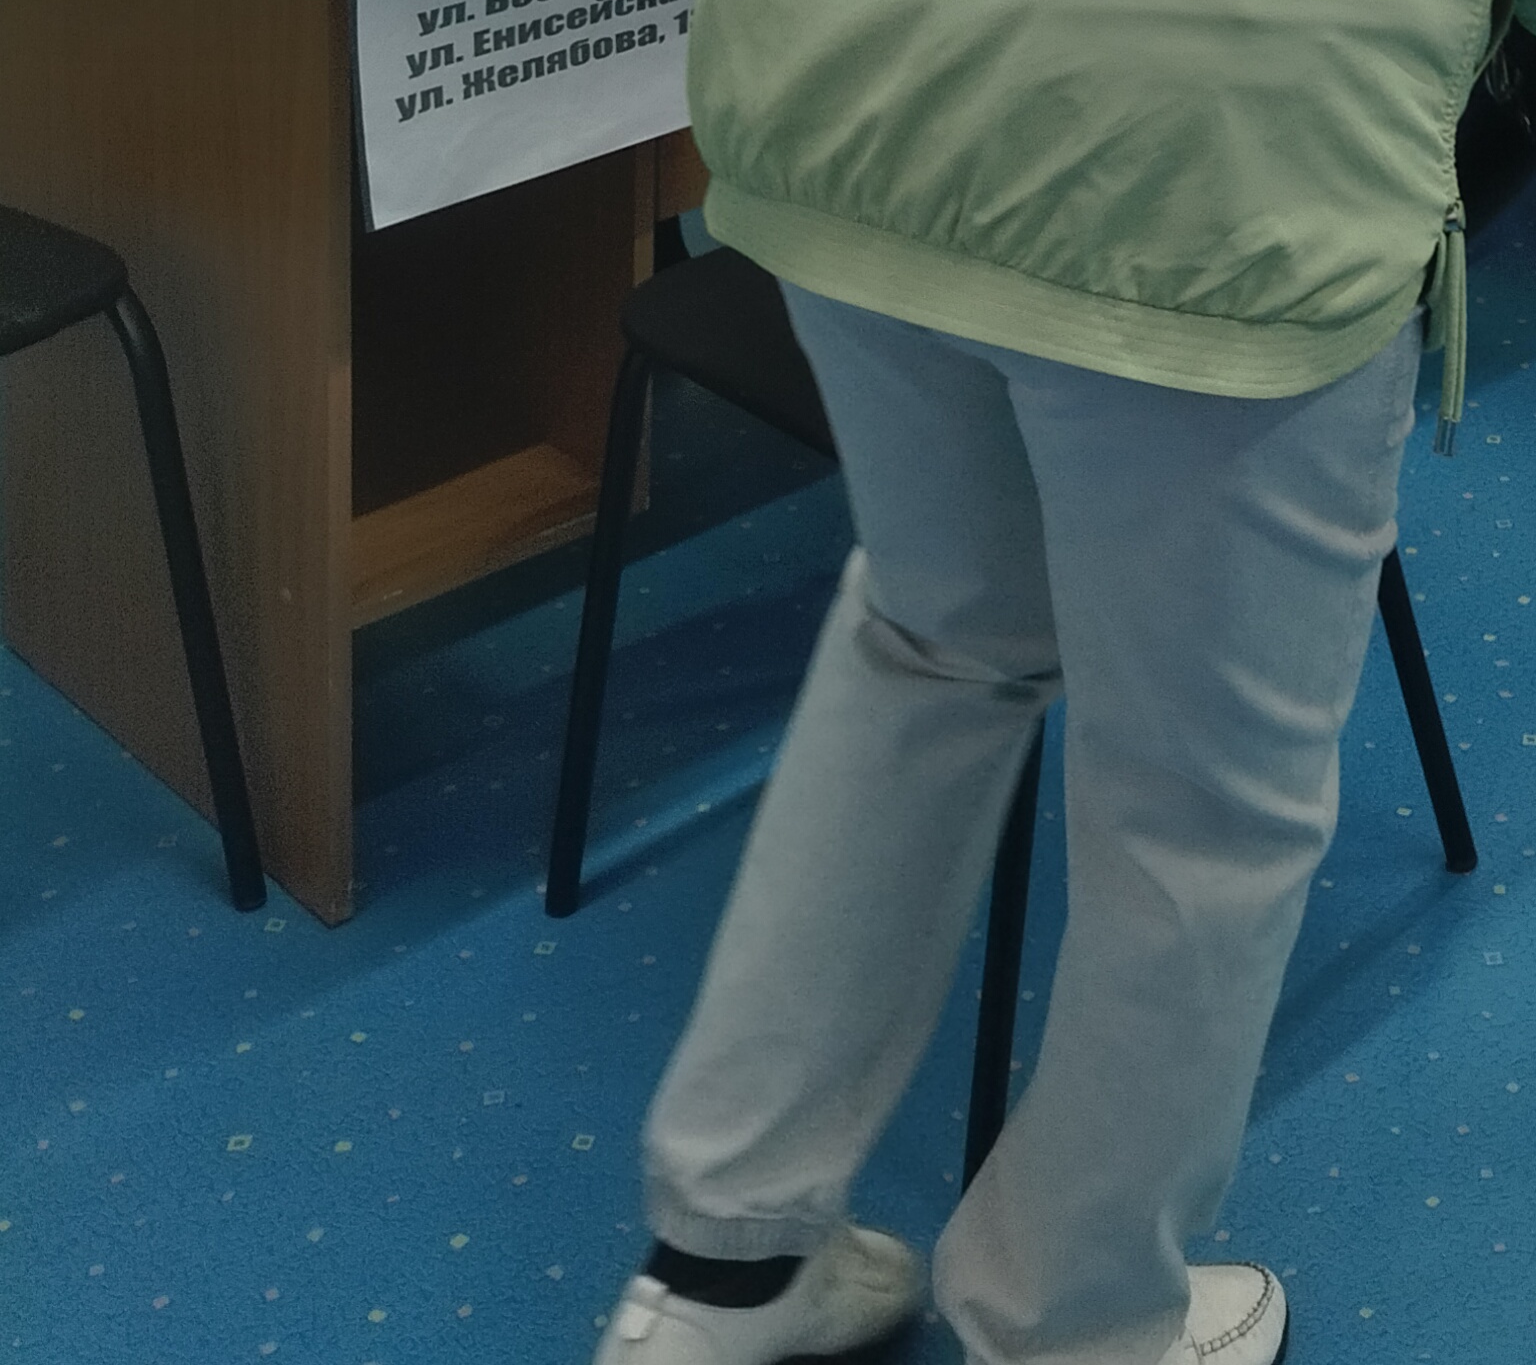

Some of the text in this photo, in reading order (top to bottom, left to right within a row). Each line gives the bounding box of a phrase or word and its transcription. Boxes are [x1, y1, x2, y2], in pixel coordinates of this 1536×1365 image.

[417, 0, 475, 36] ул.
[395, 8, 694, 122] ул. Желябова, 1
[405, 42, 464, 79] ул.
